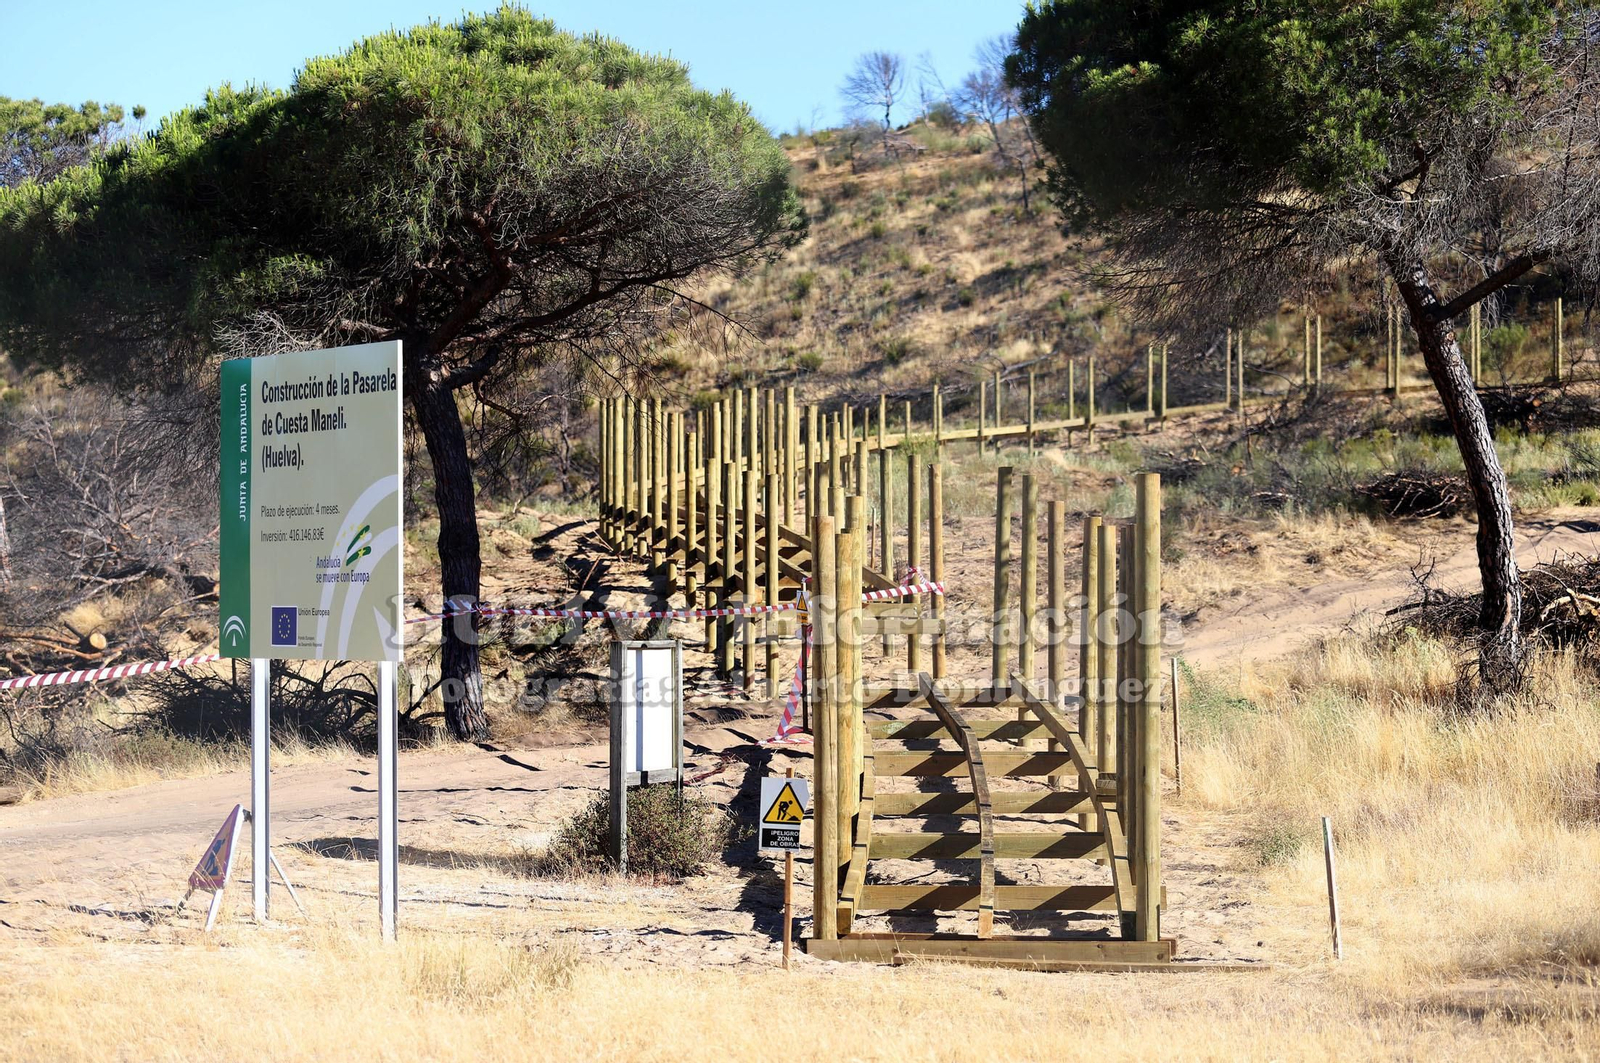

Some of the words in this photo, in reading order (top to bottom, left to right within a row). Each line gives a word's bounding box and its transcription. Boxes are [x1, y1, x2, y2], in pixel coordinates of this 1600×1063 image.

[261, 376, 324, 404] Construcción
[326, 374, 338, 397] de
[340, 372, 350, 396] la
[352, 367, 397, 394] Pasarela
[261, 413, 273, 436] de
[275, 411, 308, 435] Cuesta
[311, 406, 347, 431] Maneli.
[261, 442, 304, 472] (Huelva).
[240, 458, 247, 475] DE
[239, 481, 247, 522] JUNTA
[261, 505, 277, 517] Plazo
[277, 505, 285, 517] de
[286, 503, 315, 519] ejecución:
[315, 502, 320, 515] 4
[321, 504, 340, 515] meses.
[261, 529, 288, 542] Inversión:
[316, 573, 322, 583] se
[323, 573, 340, 583] mueve
[341, 572, 350, 582] con
[351, 569, 370, 585] Europa
[298, 607, 311, 616] Unión
[311, 607, 330, 618] Europea
